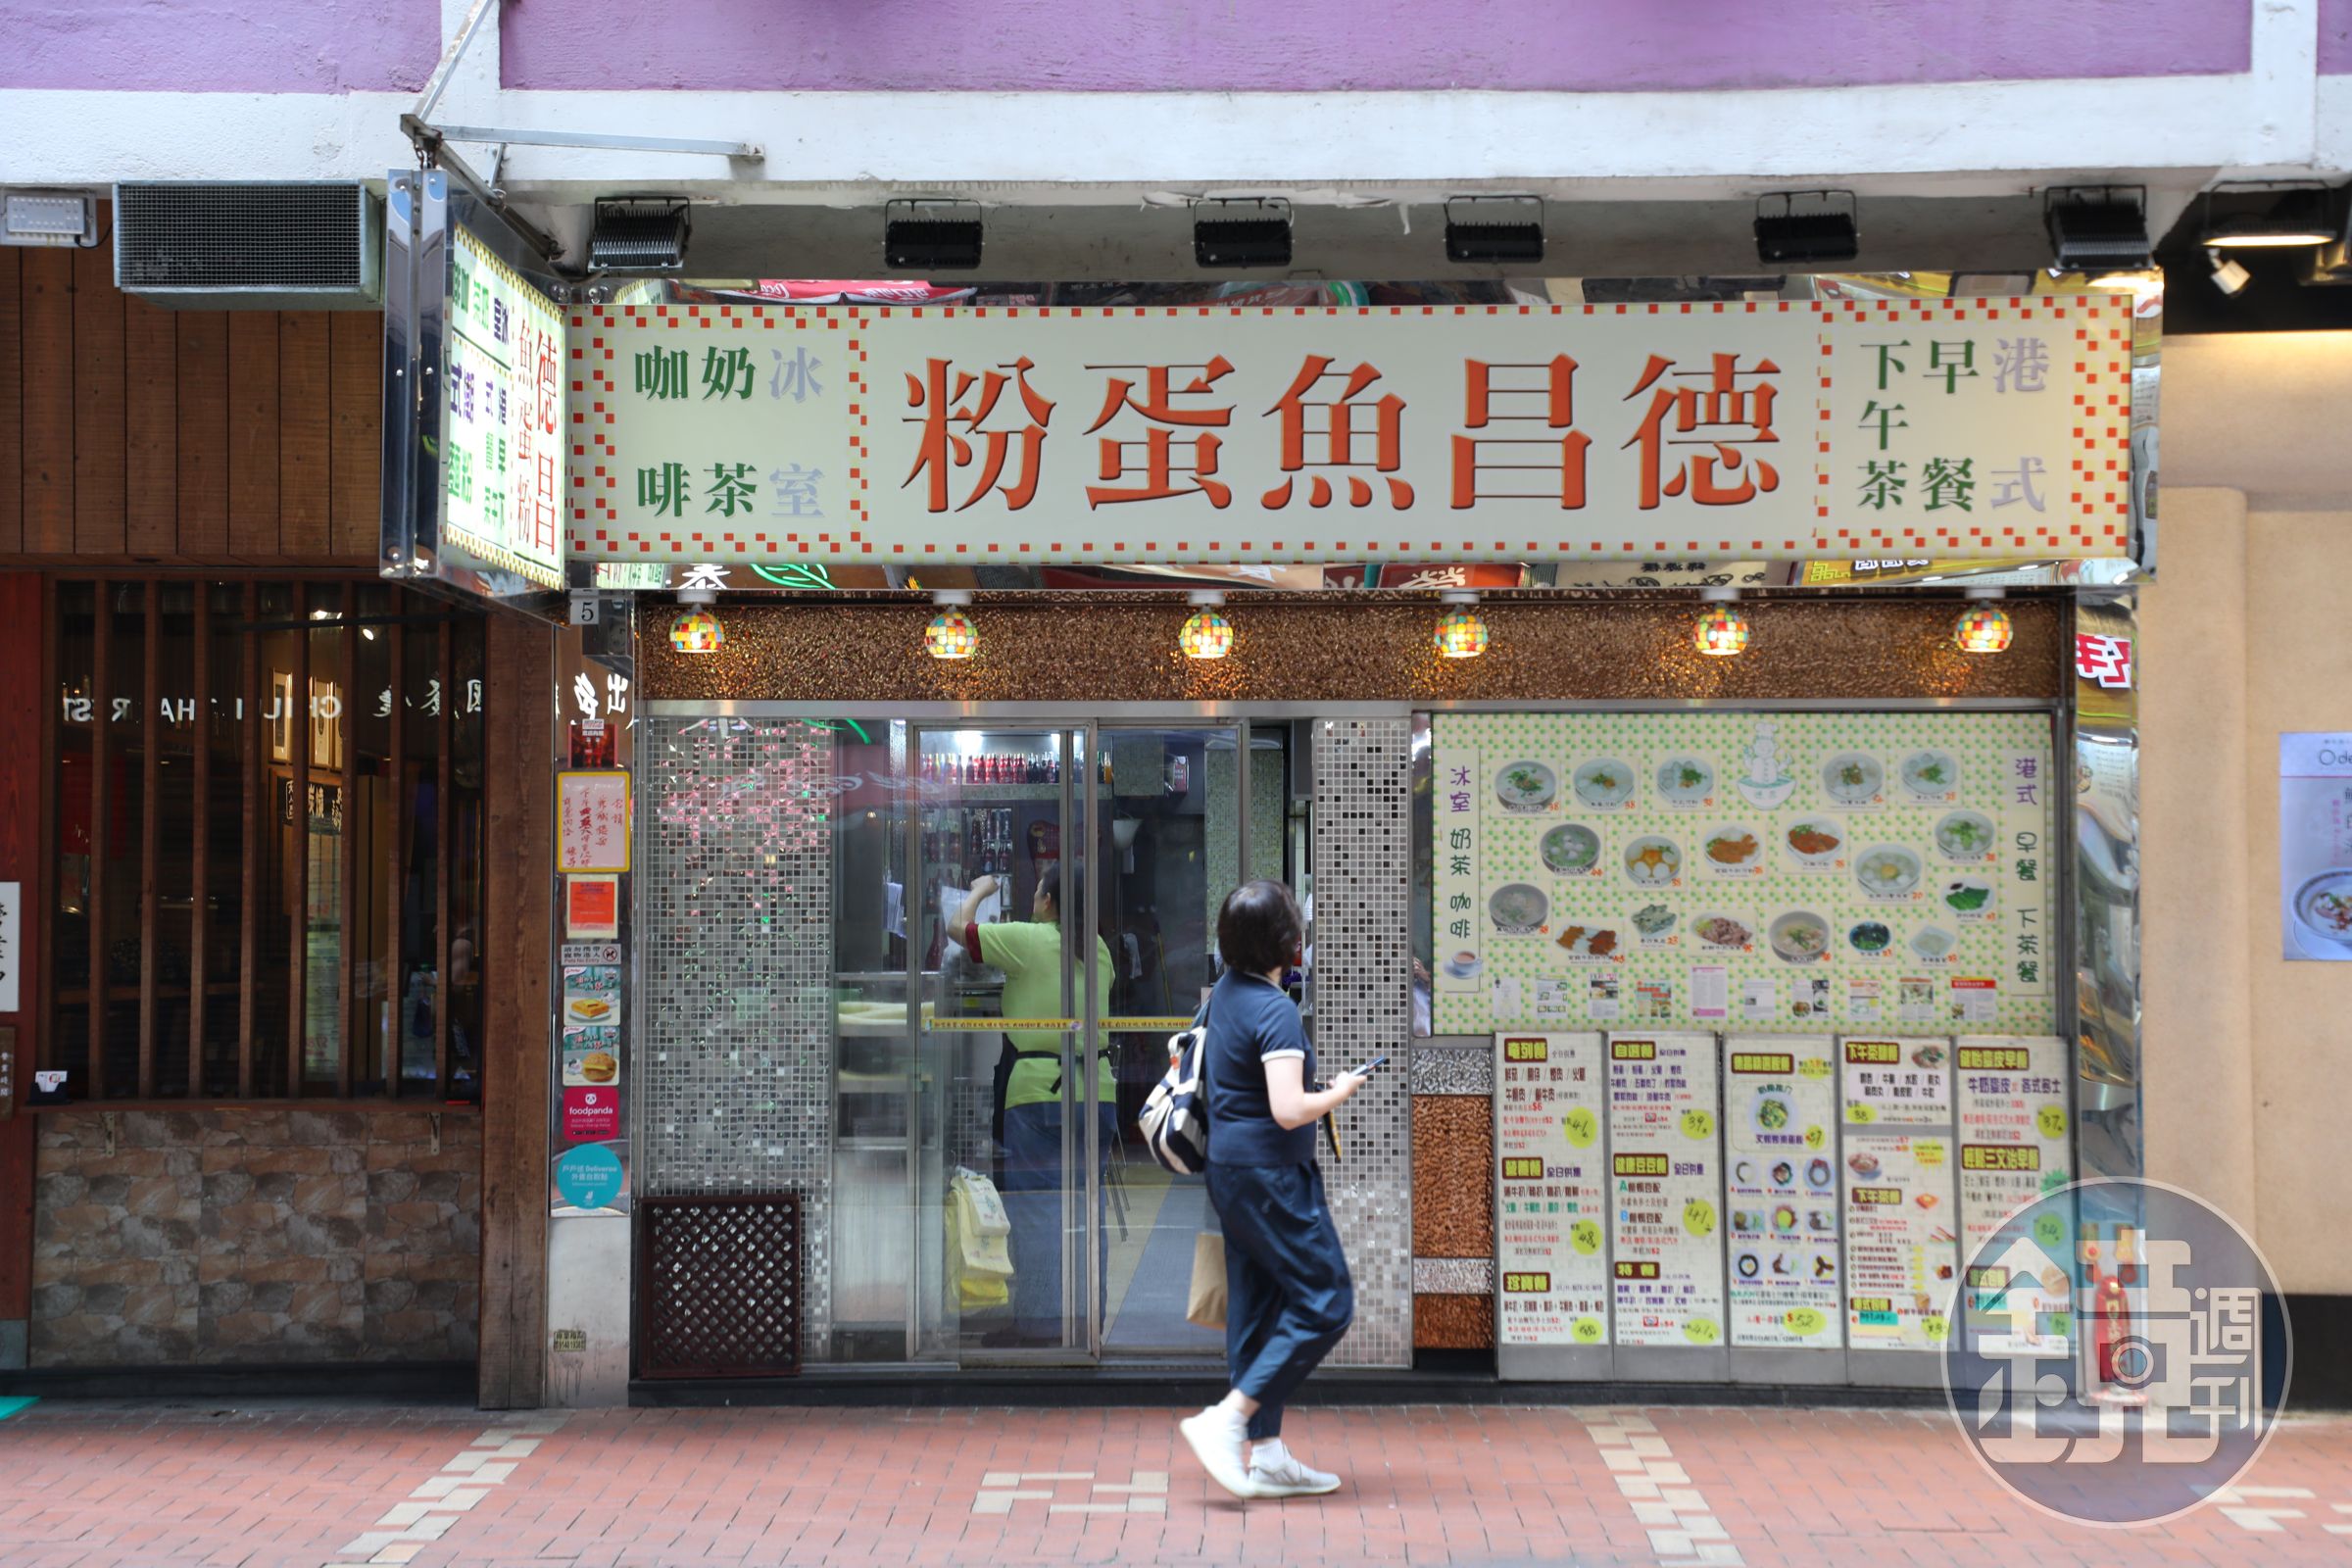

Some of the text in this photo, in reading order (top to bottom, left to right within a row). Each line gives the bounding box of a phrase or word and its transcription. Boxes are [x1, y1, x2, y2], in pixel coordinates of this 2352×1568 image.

[535, 327, 558, 557] 德昌
[634, 345, 692, 519] 咖啡
[701, 345, 759, 518] 奶茶
[767, 346, 826, 520] 冰室
[1856, 339, 1911, 511] 下午茶
[1921, 339, 1980, 513] 早餐
[1990, 337, 2049, 513] 港式
[1450, 766, 1471, 939] 冰室 奶茶 咖啡
[2015, 758, 2038, 983] 港式 早餐 下茶餐
[569, 1106, 613, 1116] foodpanda
